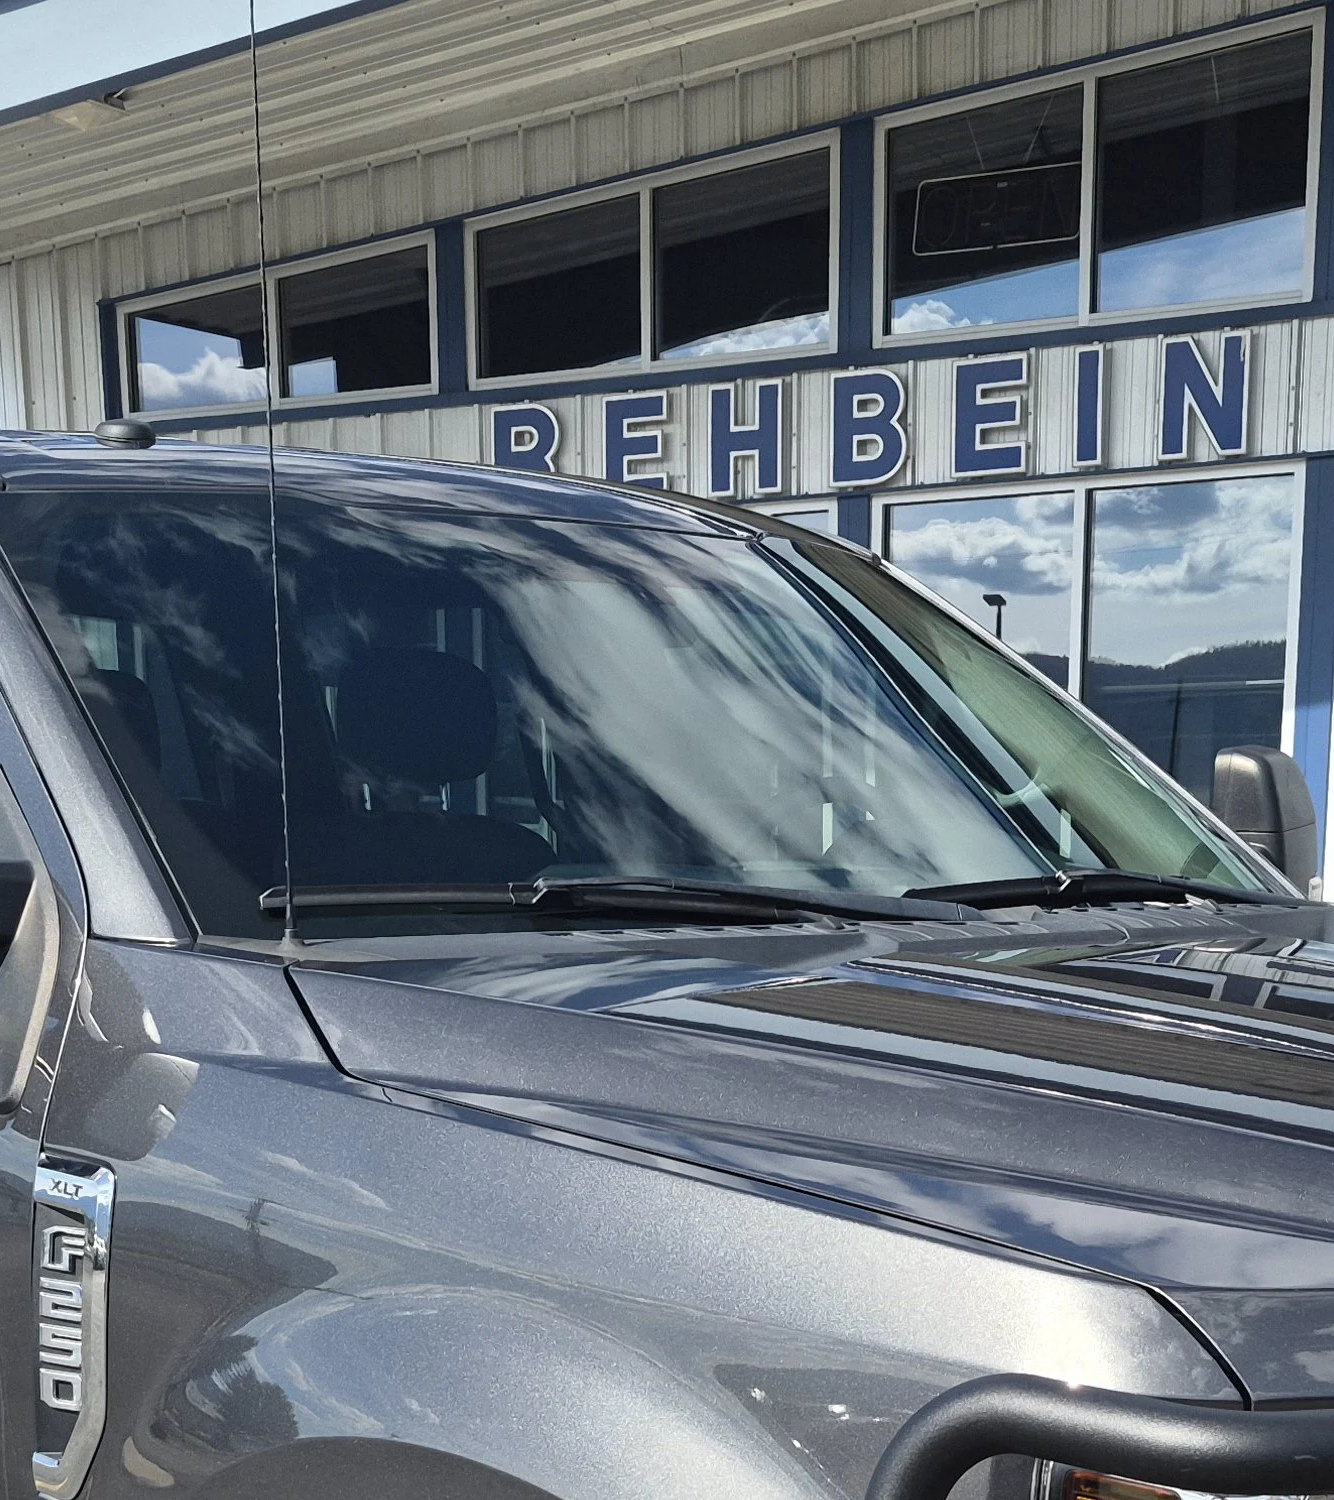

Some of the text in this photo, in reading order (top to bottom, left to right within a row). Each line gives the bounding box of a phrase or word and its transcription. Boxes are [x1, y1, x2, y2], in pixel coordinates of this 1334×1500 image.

[490, 329, 1253, 497] REHBEIN
[50, 1178, 83, 1198] XLT
[39, 1225, 86, 1412] F250
